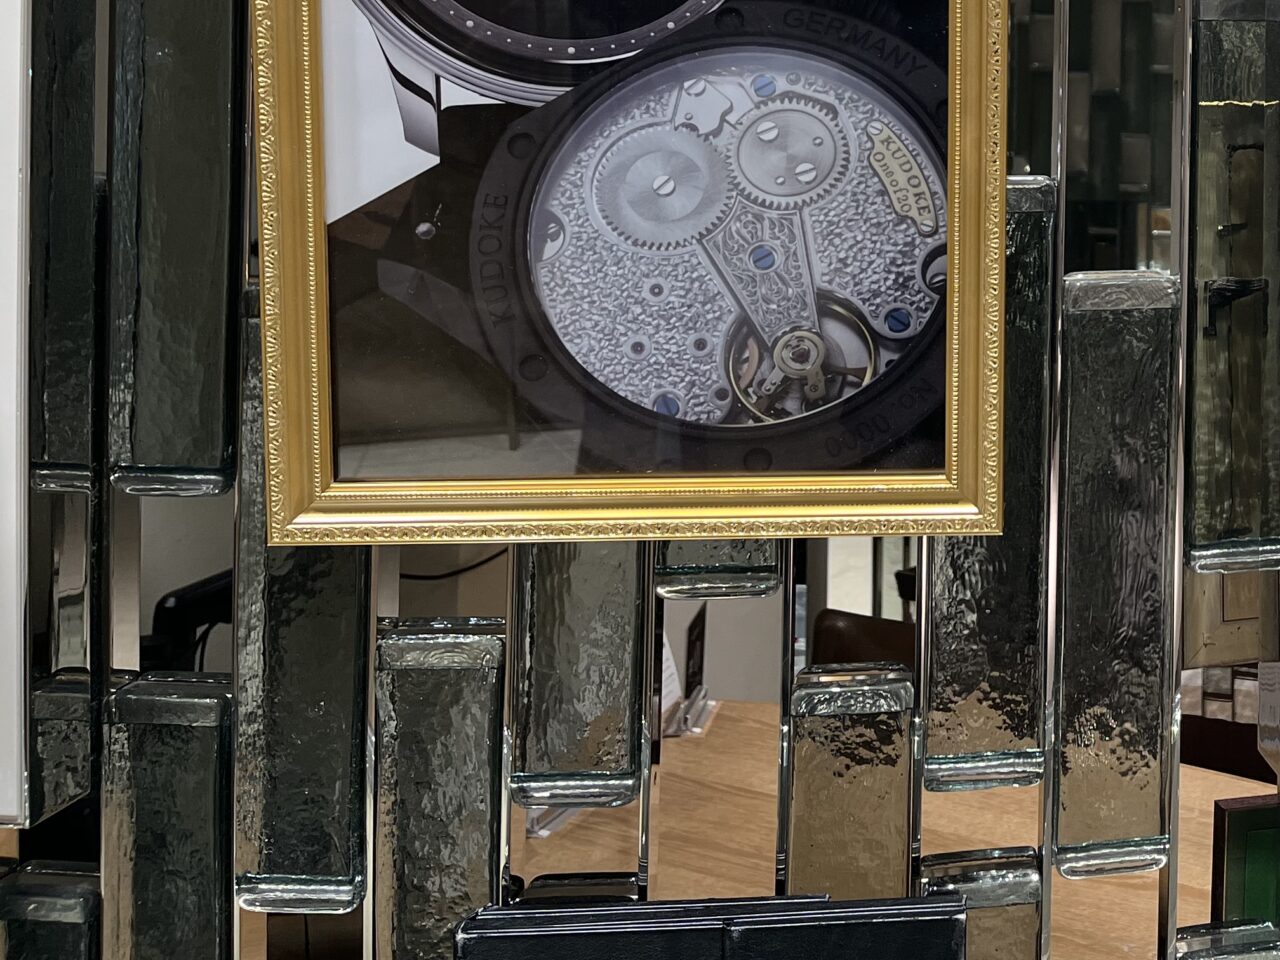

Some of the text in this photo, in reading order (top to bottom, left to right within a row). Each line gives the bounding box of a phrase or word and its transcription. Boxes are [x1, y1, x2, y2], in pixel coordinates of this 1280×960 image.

[783, 8, 928, 78] GERMANY
[880, 135, 929, 216] KUDOKE
[477, 192, 516, 329] KUDOKE
